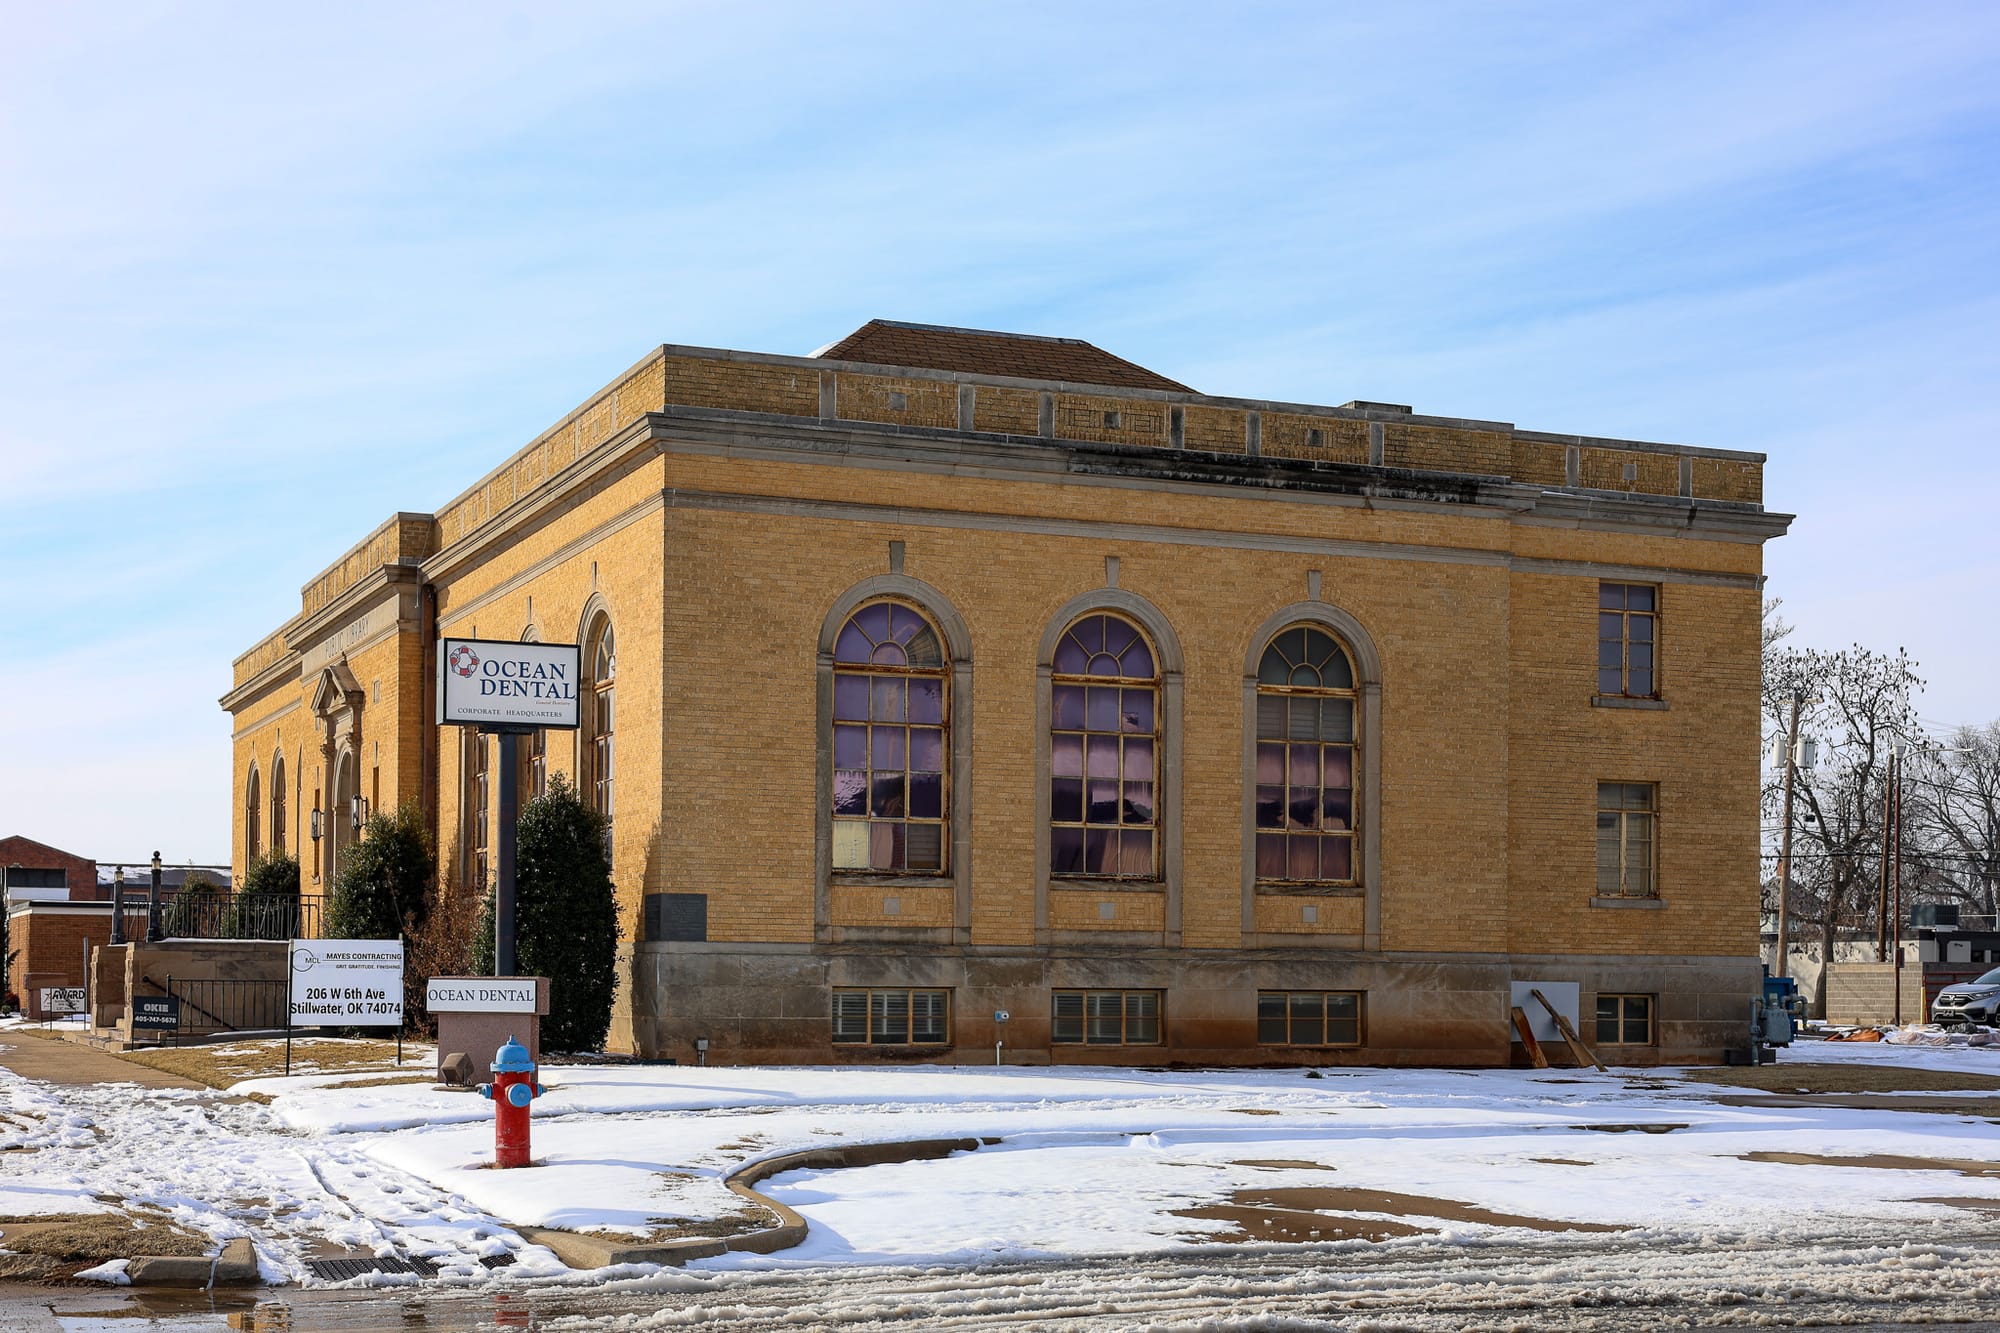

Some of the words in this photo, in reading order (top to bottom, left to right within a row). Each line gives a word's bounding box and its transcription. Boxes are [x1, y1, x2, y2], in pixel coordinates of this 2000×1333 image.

[483, 660, 566, 680] OCEAN
[480, 678, 575, 700] DENTAL
[457, 707, 501, 716] CORPORATE
[506, 709, 562, 718] HEADQUARTERS
[52, 990, 86, 1000] AWARD
[306, 988, 327, 1000] 206
[330, 988, 342, 1000] W
[344, 988, 362, 1000] 6th
[365, 988, 385, 1000] Ave
[428, 989, 475, 1001] OCEAN
[479, 989, 534, 1002] DENTAL
[143, 1003, 169, 1013] OKIE
[291, 1002, 344, 1016] Stillwater,
[347, 1002, 363, 1014] OK
[366, 1002, 401, 1014] 74074
